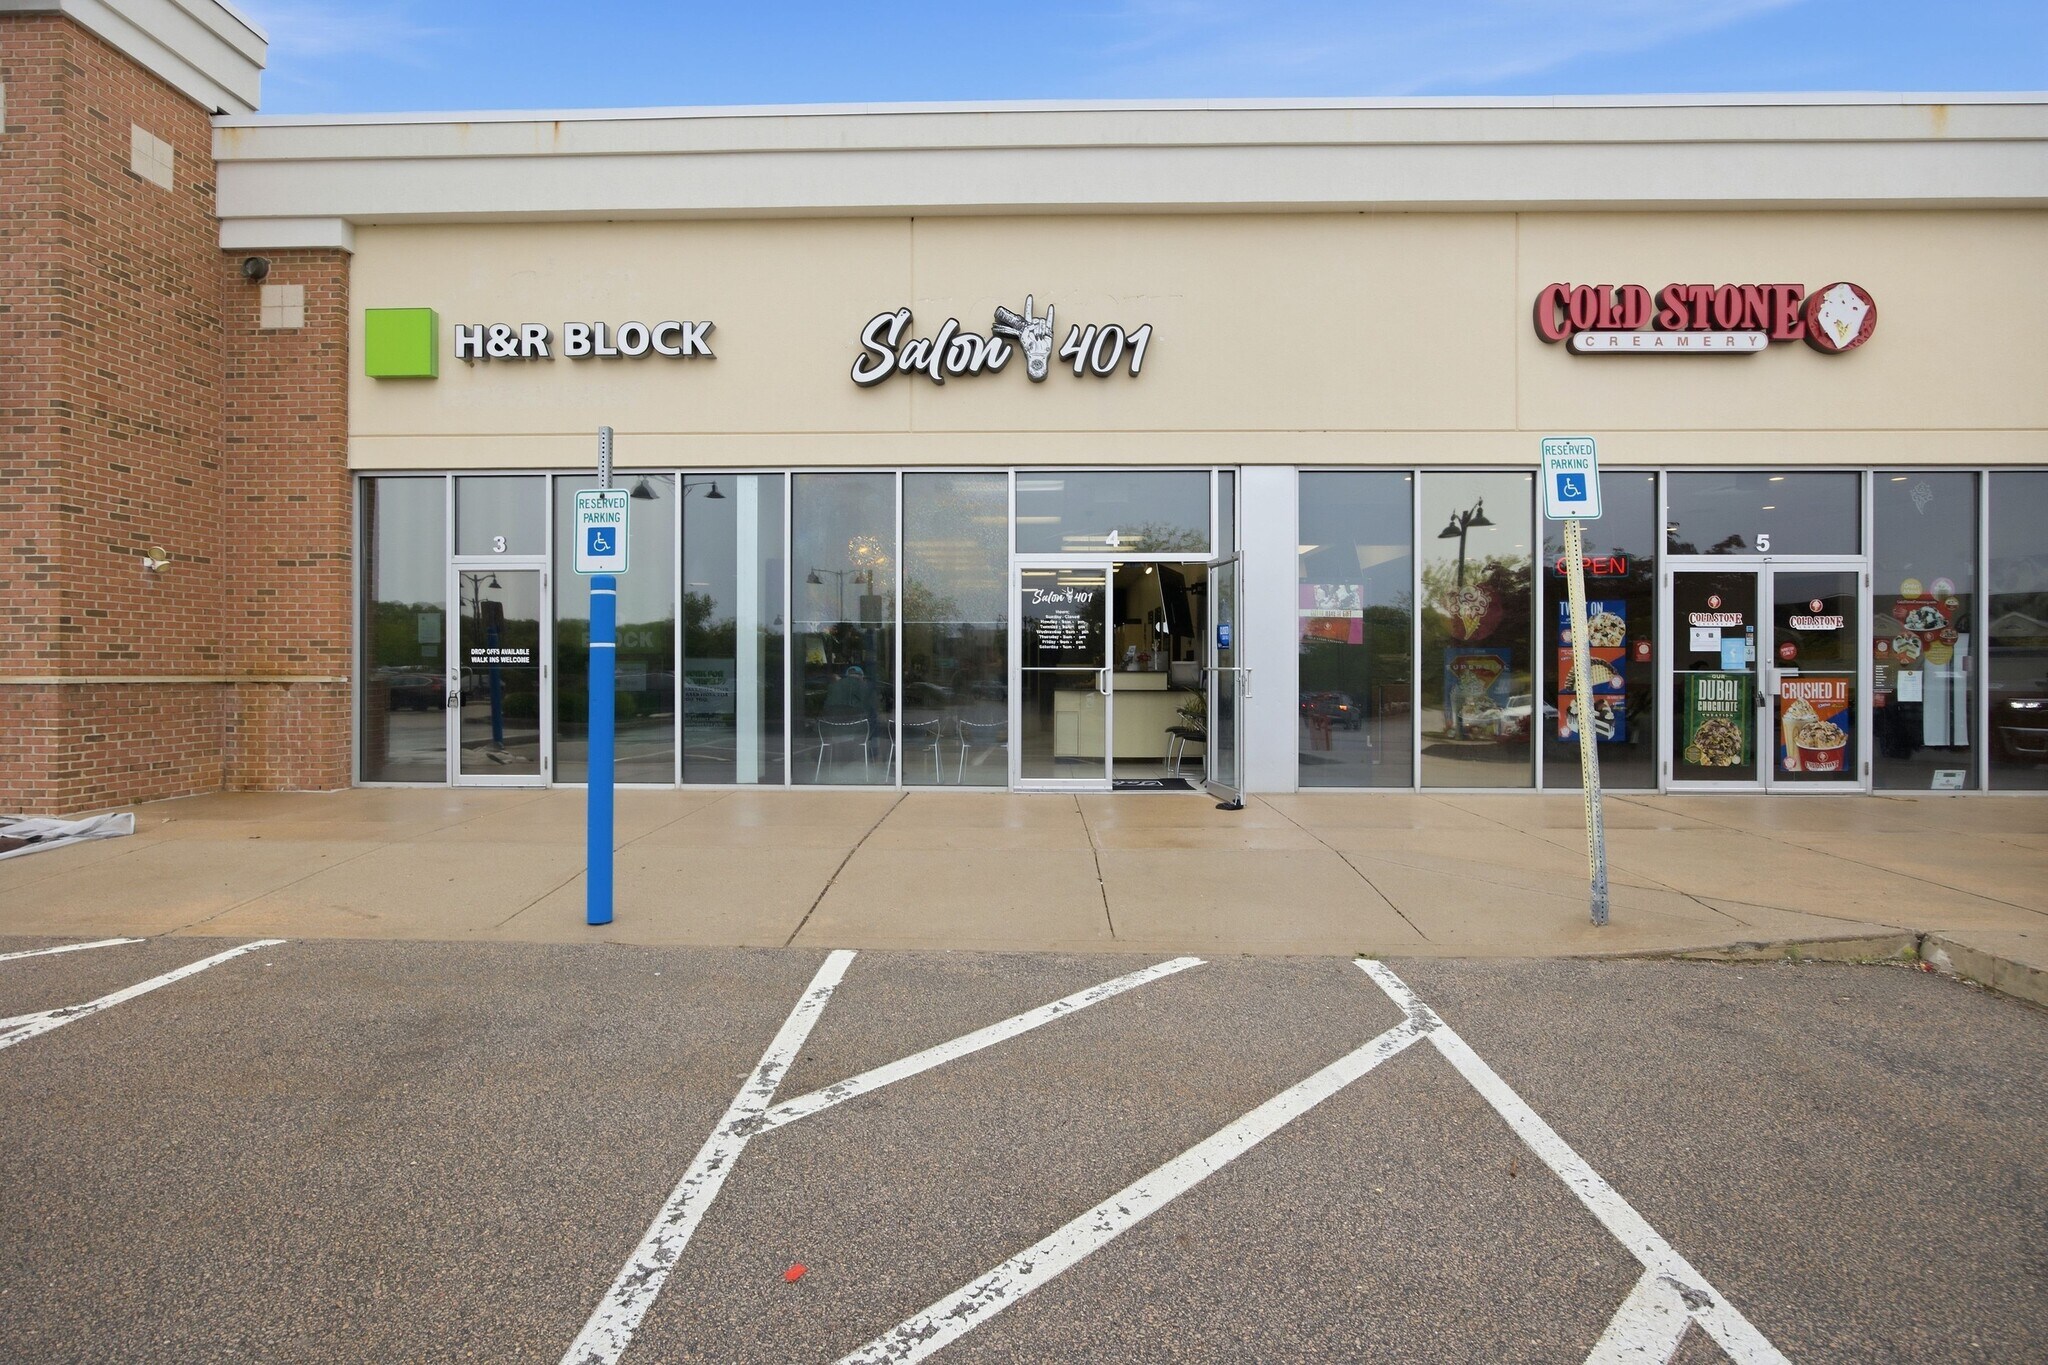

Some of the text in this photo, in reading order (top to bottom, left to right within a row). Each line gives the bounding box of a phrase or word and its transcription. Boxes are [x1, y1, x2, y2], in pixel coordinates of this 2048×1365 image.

[1534, 283, 1805, 341] COLD STONE
[454, 320, 716, 361] H&R BLOCK
[850, 307, 1153, 388] Salon 401
[1584, 335, 1759, 347] CREAMERY
[1545, 445, 1592, 455] RESERVED
[1551, 459, 1589, 469] PARKING
[579, 498, 625, 509] RESERVED
[584, 512, 621, 523] PARKING
[493, 536, 507, 553] 3
[1106, 530, 1120, 547] 4
[1756, 534, 1770, 551] 5
[1556, 557, 1625, 574] OPEN
[1032, 589, 1093, 604] Salon 401
[1590, 602, 1604, 615] ON
[1689, 613, 1743, 625] COLD STONE
[1789, 616, 1844, 628] COLD STONE
[582, 632, 654, 648] BCK
[1698, 680, 1738, 700] DUBAI
[1781, 682, 1847, 699] CRUSHED IT
[1697, 701, 1738, 711] CHOCOLATE
